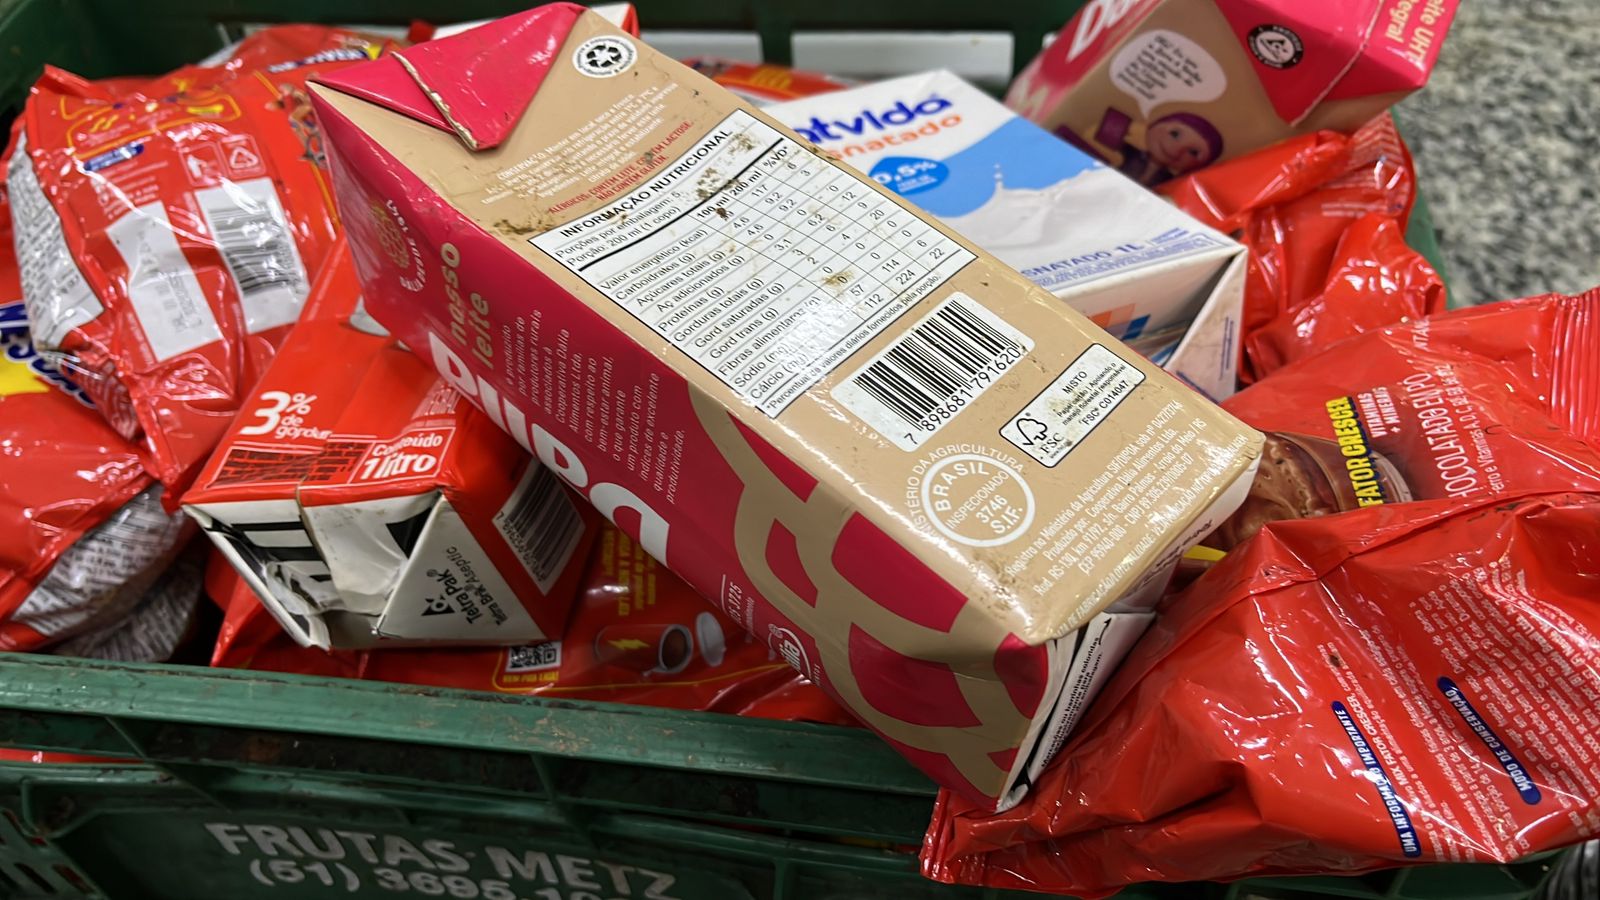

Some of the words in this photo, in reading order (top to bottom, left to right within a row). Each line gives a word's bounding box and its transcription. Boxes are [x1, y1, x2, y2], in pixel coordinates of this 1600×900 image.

[1409, 27, 1435, 72] UHT
[560, 190, 651, 238] INFORMAÇÃO
[650, 130, 733, 193] NUTRICIONAL
[697, 206, 716, 218] 100
[716, 196, 729, 207] ml
[730, 182, 749, 196] 200
[749, 171, 763, 184] ml
[555, 234, 599, 258] Porções
[601, 225, 617, 240] por
[567, 244, 608, 267] Porção:
[610, 233, 628, 247] 200
[630, 226, 641, 237] ml
[640, 222, 652, 231] (1
[653, 206, 680, 224] copo)
[600, 269, 630, 291] Valor
[630, 245, 680, 276] energético
[680, 229, 708, 255] (kcal)
[752, 184, 769, 197] 117
[787, 162, 797, 170] 6
[658, 296, 708, 332] Proteínas
[707, 286, 725, 301] (g)
[774, 238, 793, 252] 3,1
[807, 213, 825, 227] 6,2
[842, 192, 857, 201] 12
[673, 305, 721, 343] Gorduras
[721, 288, 747, 309] totais
[746, 278, 764, 293] (g)
[826, 224, 836, 233] 6
[857, 201, 868, 209] 9
[1021, 251, 1111, 277] SNATADO
[441, 242, 467, 346] nosso
[735, 363, 765, 388] Sódio
[850, 284, 865, 296] 57
[882, 259, 900, 274] 114
[917, 239, 927, 248] 6
[470, 292, 494, 369] leite
[751, 371, 784, 399] Cálcio
[864, 293, 884, 309] 112
[896, 269, 916, 286] 224
[929, 248, 945, 260] 22
[820, 347, 845, 370] valores
[844, 331, 869, 353] diários
[868, 305, 902, 338] fornecidos
[900, 293, 917, 310] pela
[914, 275, 941, 301] porção.
[590, 357, 597, 374] ao
[1062, 369, 1088, 395] MISTO
[240, 391, 317, 436] 3%
[569, 383, 582, 433] Alimentos
[586, 375, 596, 421] respeito
[617, 390, 626, 431] garante
[632, 385, 642, 410] com
[904, 433, 918, 445] 7
[922, 389, 974, 431] 898681
[970, 348, 1021, 389] 791620
[1097, 379, 1129, 410] C014047
[1357, 392, 1388, 438] VITAMINAS
[1372, 387, 1401, 426] MINERAIS
[280, 413, 304, 426] de
[584, 422, 594, 443] com
[597, 398, 610, 453] bem-estar
[629, 415, 641, 455] produto
[1325, 396, 1371, 456] CRESCER
[614, 432, 624, 451] que
[912, 459, 931, 475] DA
[930, 443, 1024, 473] AGRICULTURA
[1039, 430, 1064, 455] FSC
[360, 458, 379, 480] 1
[378, 454, 437, 479] litro
[627, 456, 635, 471] um
[654, 444, 666, 492] qualidade
[666, 429, 685, 505] produtividade.
[1346, 454, 1384, 507] FATOR
[933, 462, 990, 512] BRASIL
[945, 470, 1009, 529] INSPECIONADO
[976, 494, 1008, 523] 3746
[990, 506, 1023, 534] S.I.F.
[447, 546, 480, 584] Aseptic
[455, 593, 483, 624] Tetra
[486, 605, 508, 625] Tetra
[1333, 704, 1377, 768] IMPORTANTE
[1443, 686, 1501, 750] CONSERVAÇÃO
[1371, 733, 1398, 766] FATOR
[1494, 747, 1512, 764] DE
[1390, 763, 1409, 785] MIX
[1503, 760, 1534, 792] MODO
[205, 822, 470, 873] FRUTAS
[484, 845, 682, 899] METZ
[1401, 829, 1418, 854] UMA
[249, 858, 360, 891] (51)
